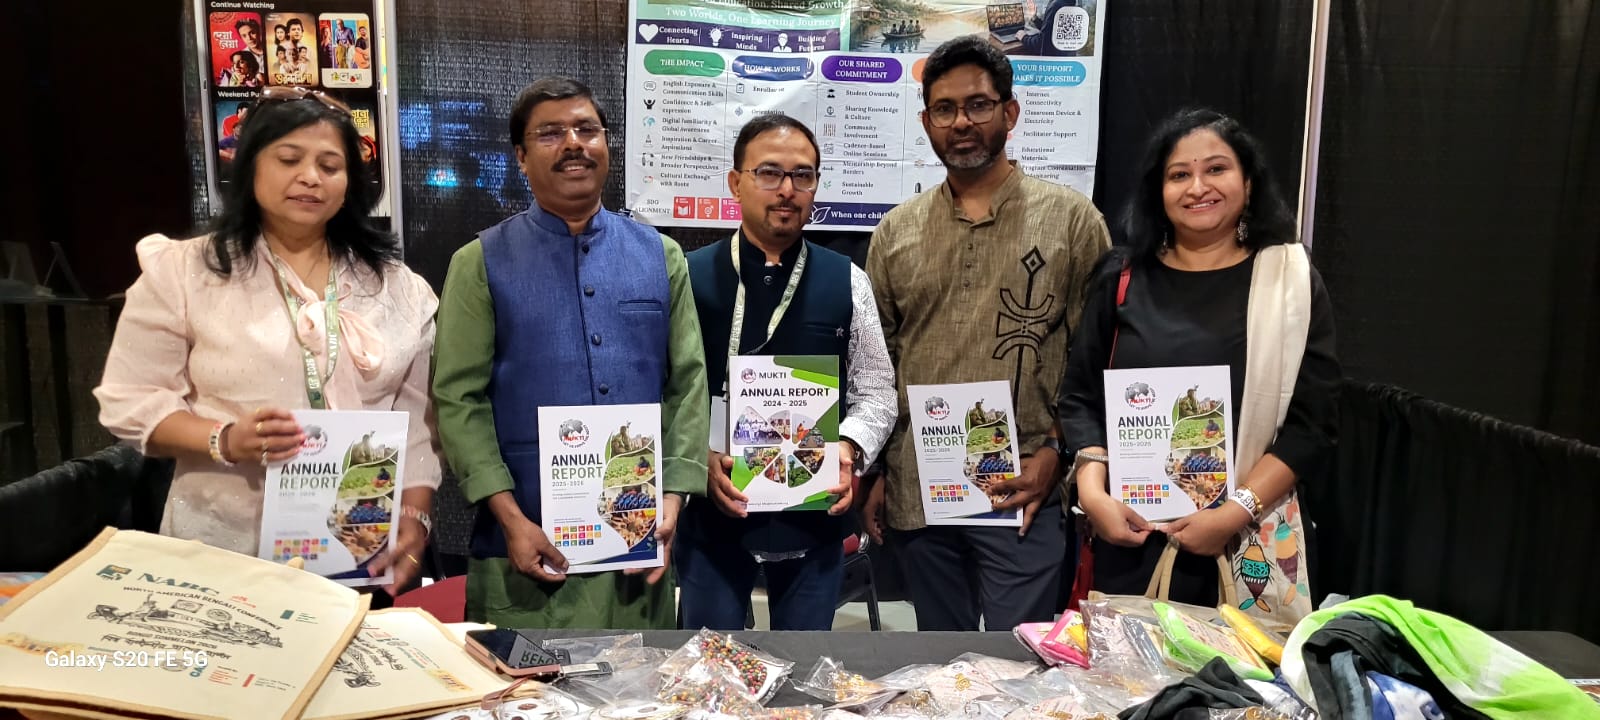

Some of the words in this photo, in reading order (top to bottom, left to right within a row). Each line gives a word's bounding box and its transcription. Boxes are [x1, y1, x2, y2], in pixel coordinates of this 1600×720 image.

[770, 1, 805, 9] Shared
[666, 7, 686, 17] Two
[728, 13, 748, 24] One
[751, 15, 795, 27] Learning
[797, 17, 836, 27] Journey
[659, 26, 698, 36] Connecting
[666, 36, 690, 44] Hearts
[731, 32, 763, 42] Inspiring
[798, 35, 826, 43] Building
[736, 42, 757, 50] Minds
[676, 59, 705, 68] IMPACT
[838, 60, 855, 68] OUR
[855, 60, 885, 69] SHARED
[1017, 64, 1038, 72] YOUR
[1038, 64, 1073, 72] SUPPORT
[744, 64, 762, 73] HOW
[774, 65, 801, 73] WORKS
[835, 70, 888, 79] COMMITMENT
[1044, 75, 1081, 83] POSSIBLE
[663, 80, 683, 88] English
[845, 105, 866, 113] Sharing
[867, 106, 898, 114] Knowledge
[740, 388, 786, 397] ANNUAL
[788, 388, 830, 397] REPORT
[1118, 415, 1170, 428] ANNUAL
[921, 425, 964, 436] ANNUAL
[1118, 428, 1171, 440] REPORT
[922, 436, 965, 447] REPORT
[551, 453, 603, 466] ANNUAL
[280, 463, 339, 475] ANNUAL
[551, 467, 603, 480] REPORT
[279, 476, 338, 489] REPORT
[137, 573, 219, 596] NABC
[156, 591, 200, 600] AMERICAN
[202, 596, 237, 610] BENGALI
[237, 608, 282, 630] CONFERENCE
